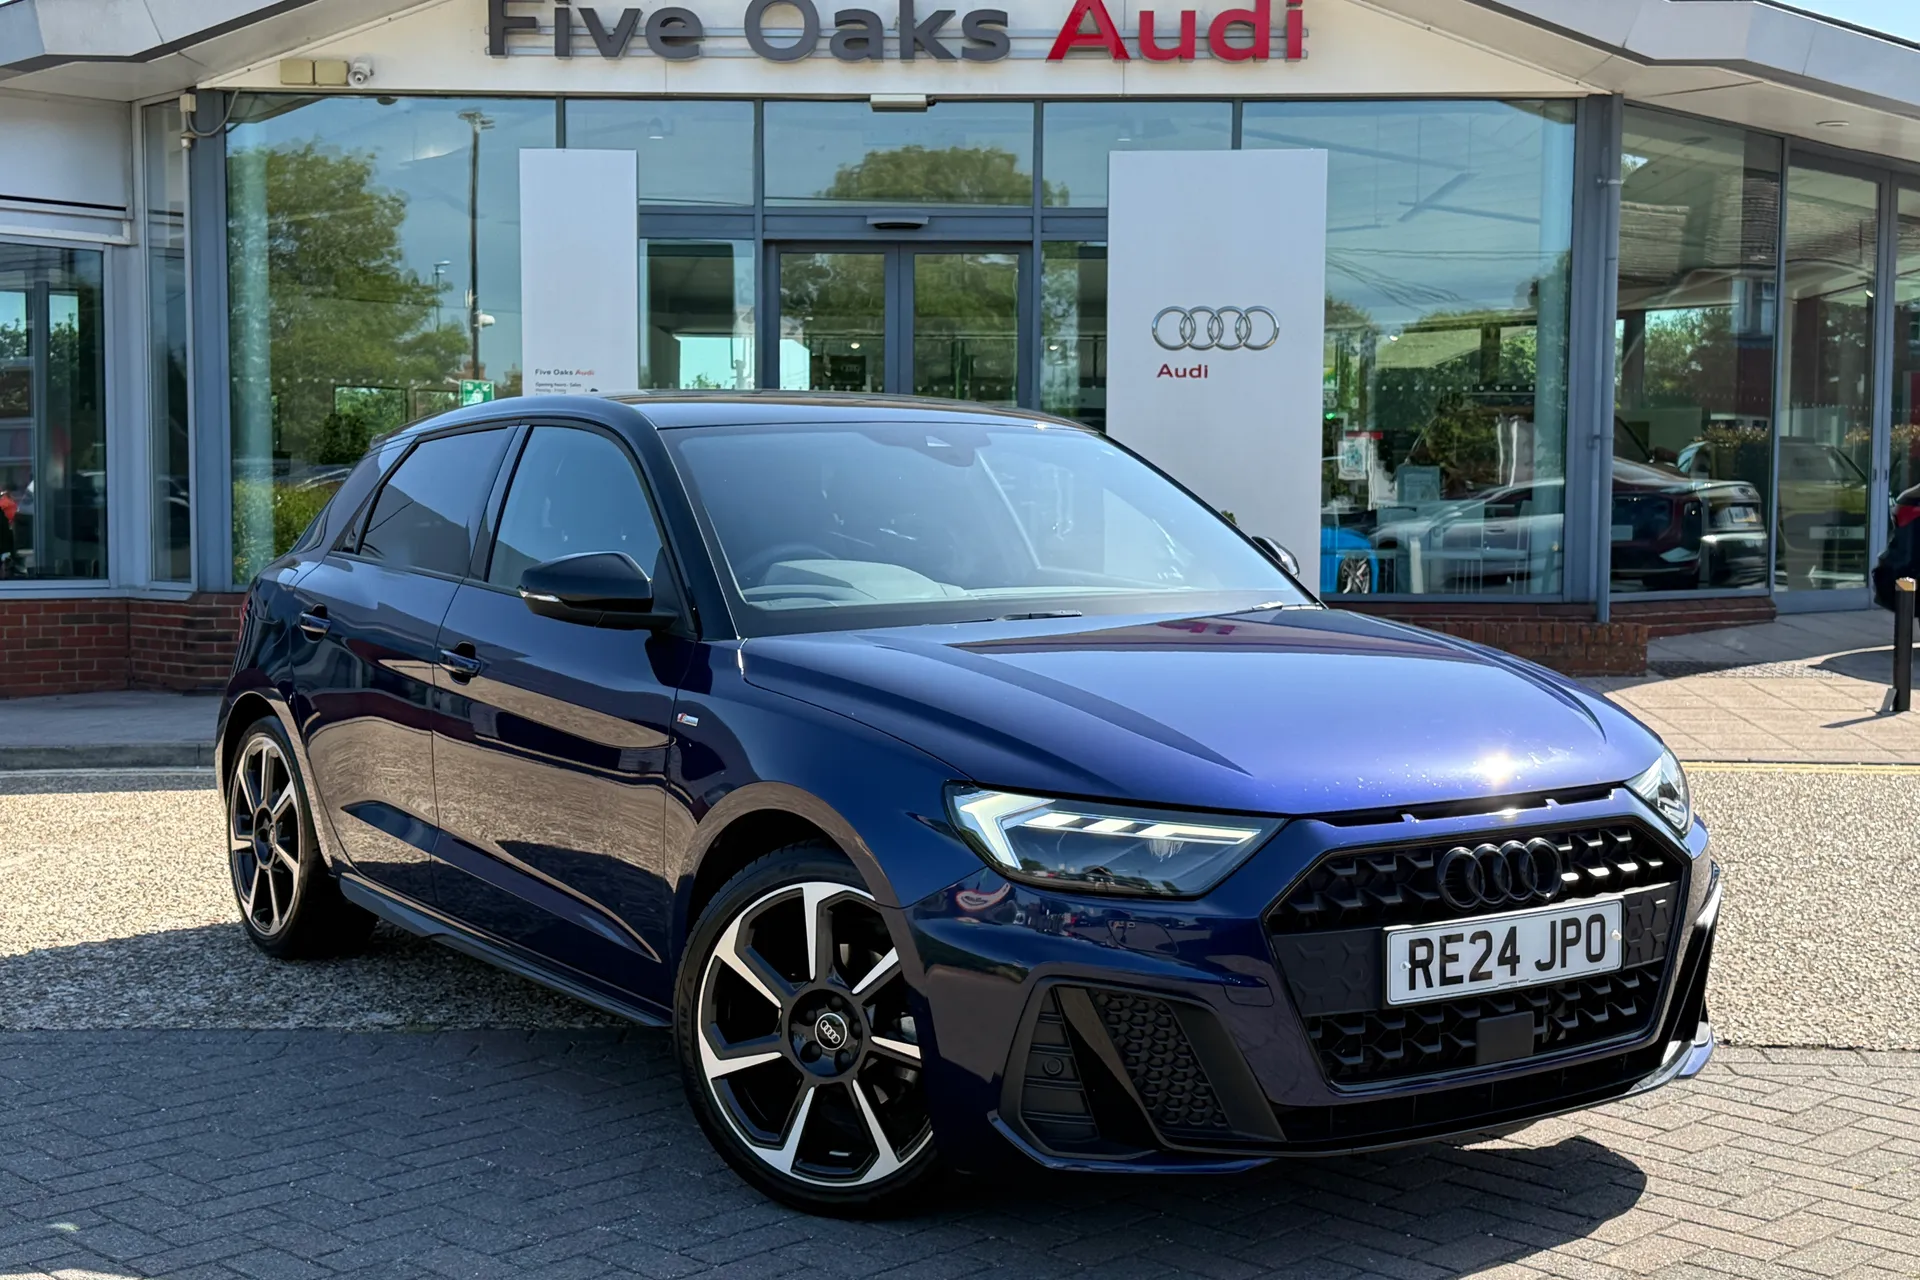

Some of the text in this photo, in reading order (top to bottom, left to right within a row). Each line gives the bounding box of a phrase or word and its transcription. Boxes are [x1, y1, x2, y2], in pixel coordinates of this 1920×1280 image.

[489, 0, 1304, 63] Five Oaks Audi
[1157, 363, 1208, 379] Audi
[1408, 913, 1606, 991] RE24 JPO
